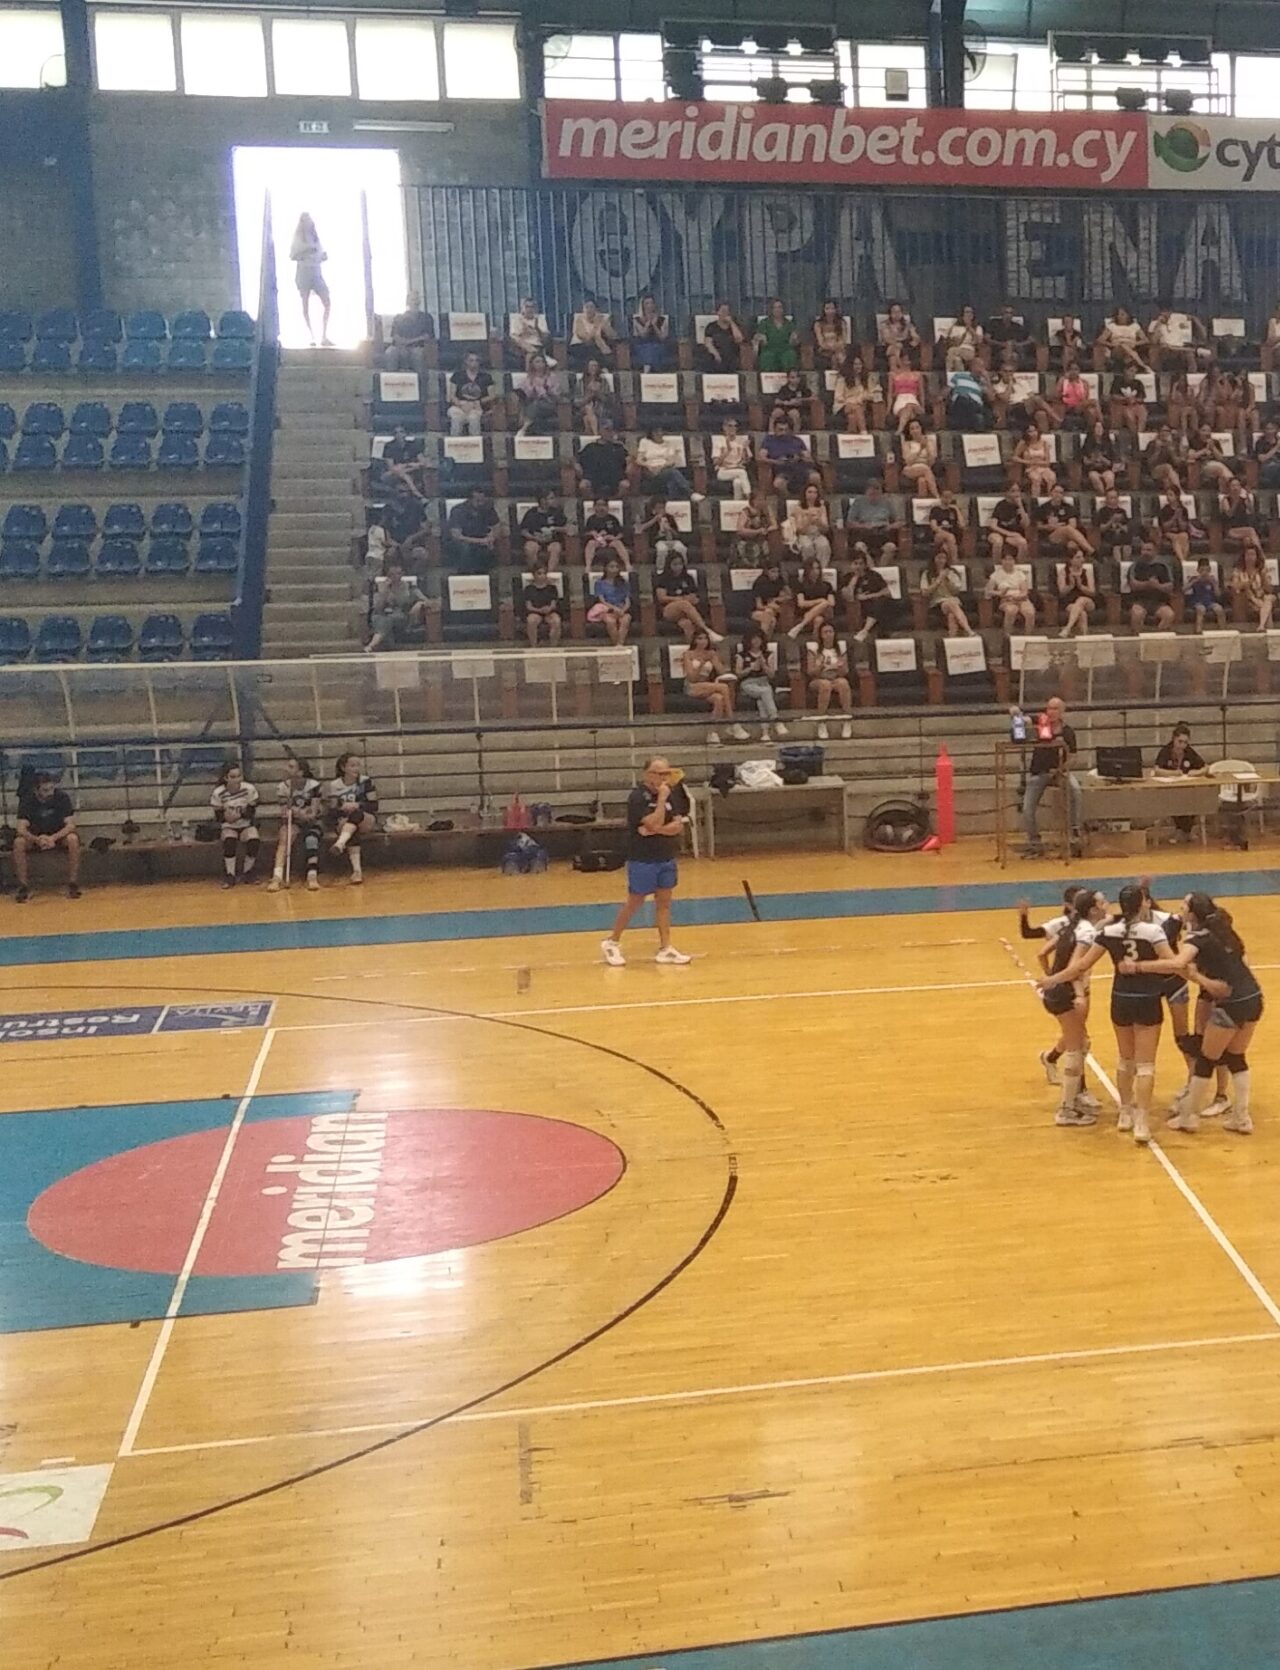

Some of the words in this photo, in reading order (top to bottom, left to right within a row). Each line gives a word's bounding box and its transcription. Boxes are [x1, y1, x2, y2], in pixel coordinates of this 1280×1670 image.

[558, 103, 1138, 184] meridianbet.com.cy
[1122, 939, 1139, 962] 3
[261, 1112, 389, 1269] meridian
